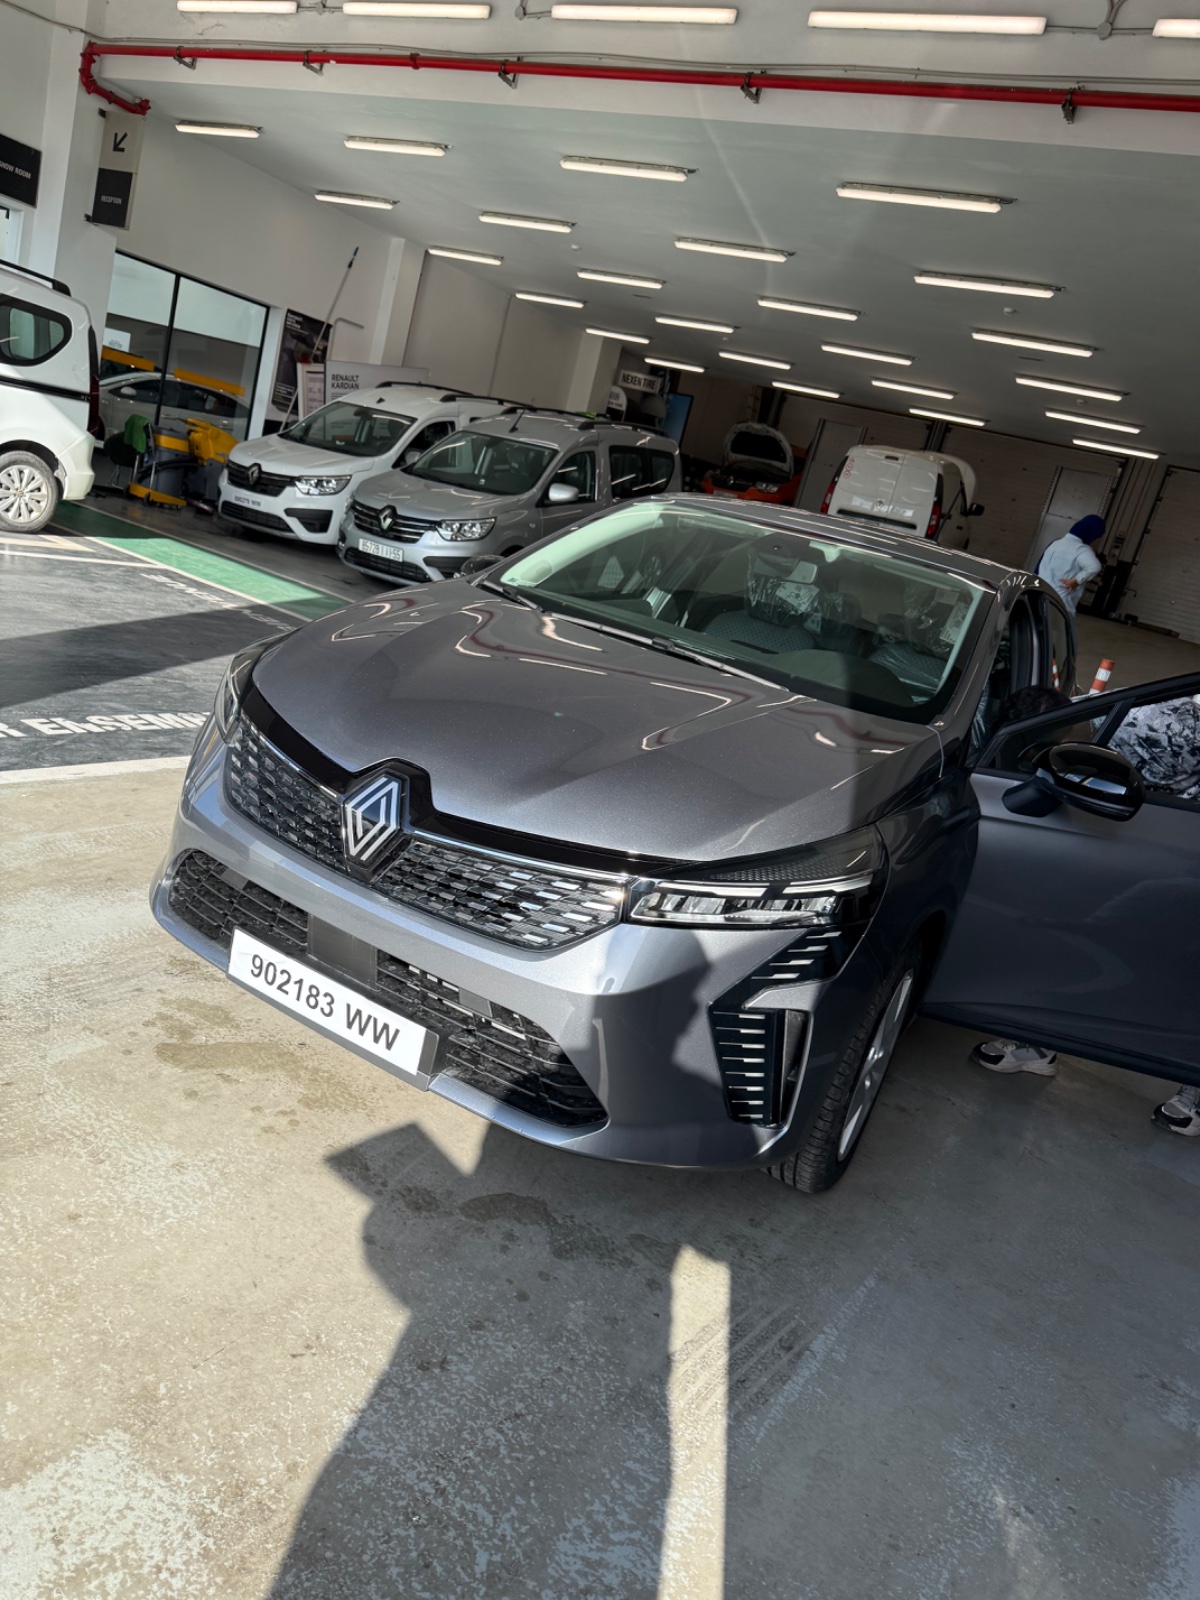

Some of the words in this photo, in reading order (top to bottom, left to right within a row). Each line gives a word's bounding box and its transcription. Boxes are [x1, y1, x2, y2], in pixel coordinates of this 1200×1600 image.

[15, 166, 31, 179] ROOM
[331, 373, 360, 382] RENAULT
[622, 373, 642, 387] NEXEN
[643, 378, 657, 390] TIRE
[331, 382, 360, 391] KARDIAN
[20, 711, 211, 736] ENSEMB
[250, 954, 335, 1018] 902183
[345, 1002, 400, 1052] WW
